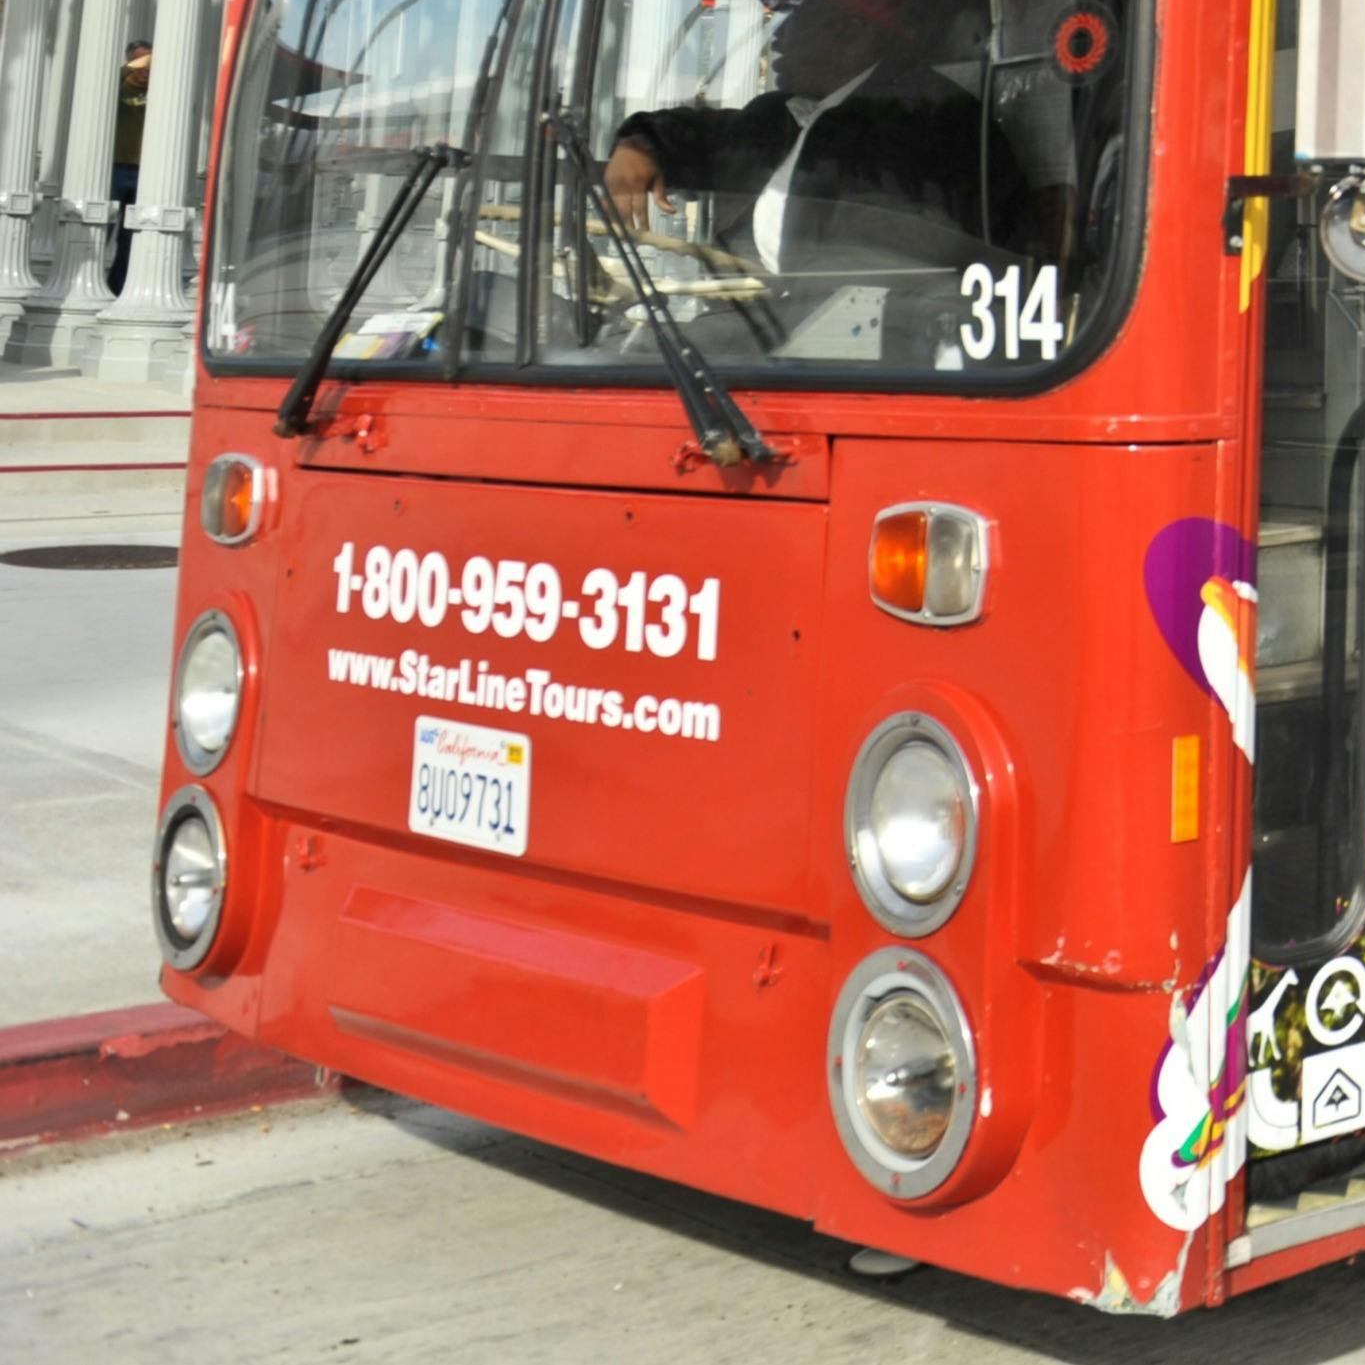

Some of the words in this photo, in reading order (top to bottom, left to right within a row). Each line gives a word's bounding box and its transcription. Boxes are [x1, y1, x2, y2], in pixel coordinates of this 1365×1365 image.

[959, 261, 1065, 362] 314
[333, 542, 721, 661] 1-800-959-3131
[327, 649, 721, 741] www.StarLineTours.com
